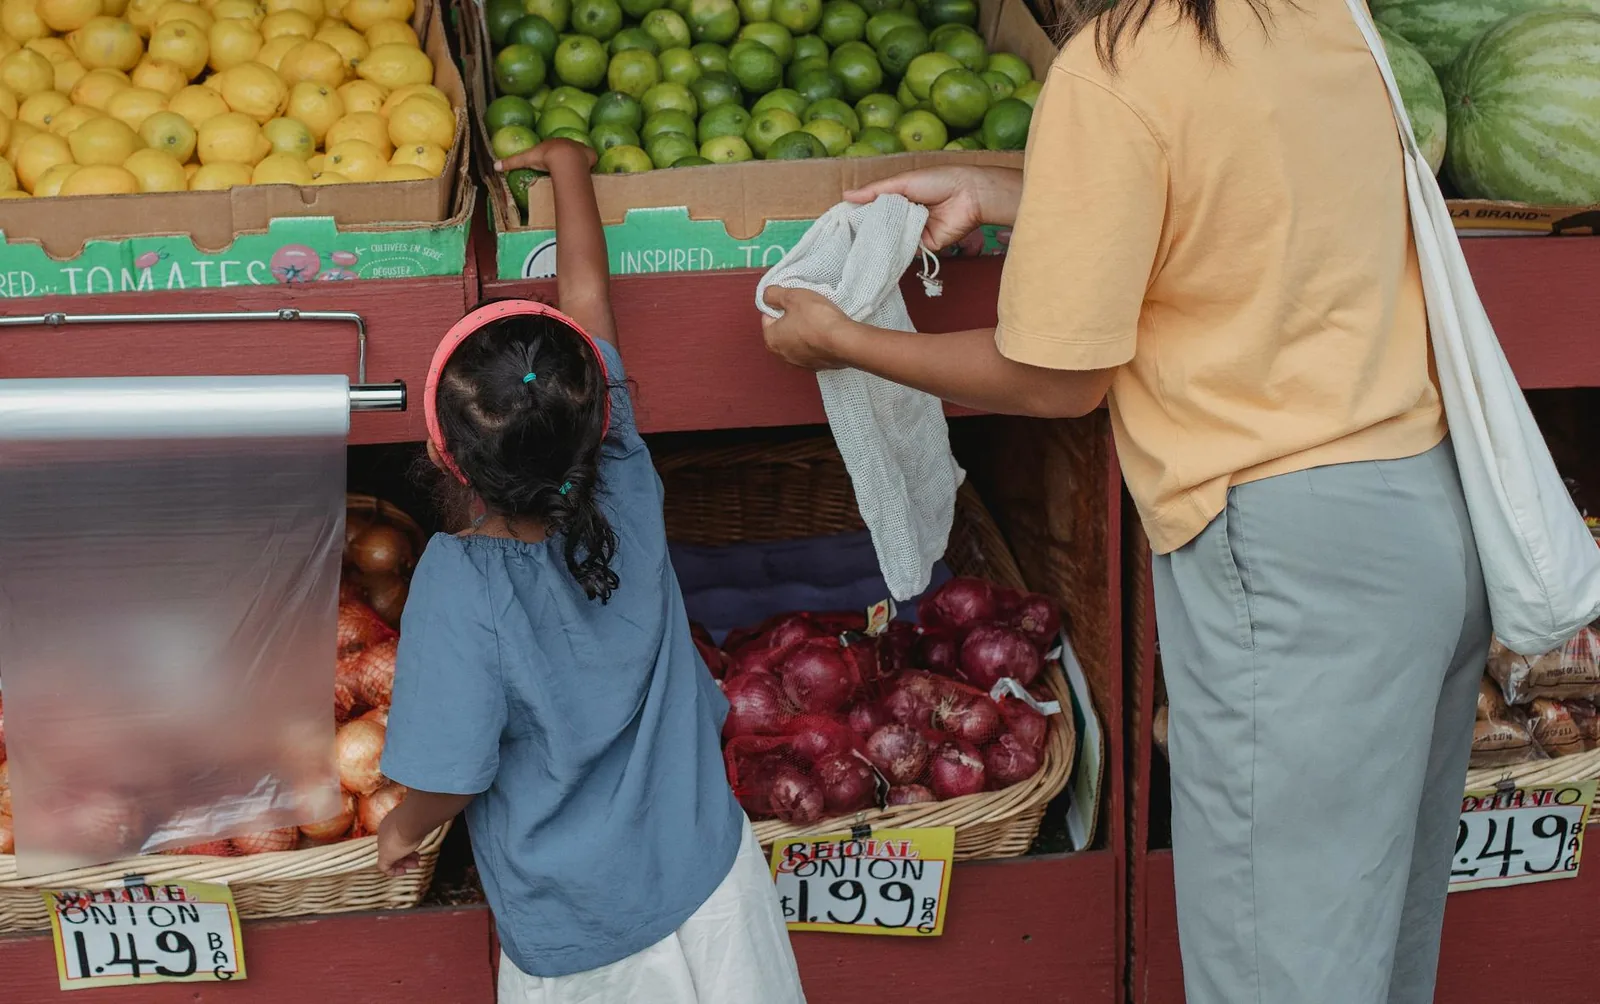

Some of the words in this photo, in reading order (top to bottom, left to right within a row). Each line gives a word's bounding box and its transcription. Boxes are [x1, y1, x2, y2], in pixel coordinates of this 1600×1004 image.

[410, 244, 421, 252] EN
[620, 247, 714, 274] INSPIRED
[60, 260, 266, 295] TOMATES
[1462, 788, 1582, 813] OTATO
[1564, 822, 1582, 872] BAG
[794, 858, 924, 880] ONION
[60, 903, 200, 928] ONION
[917, 897, 936, 934] BAG
[74, 930, 197, 978] 1.49
[207, 932, 235, 980] BAG
